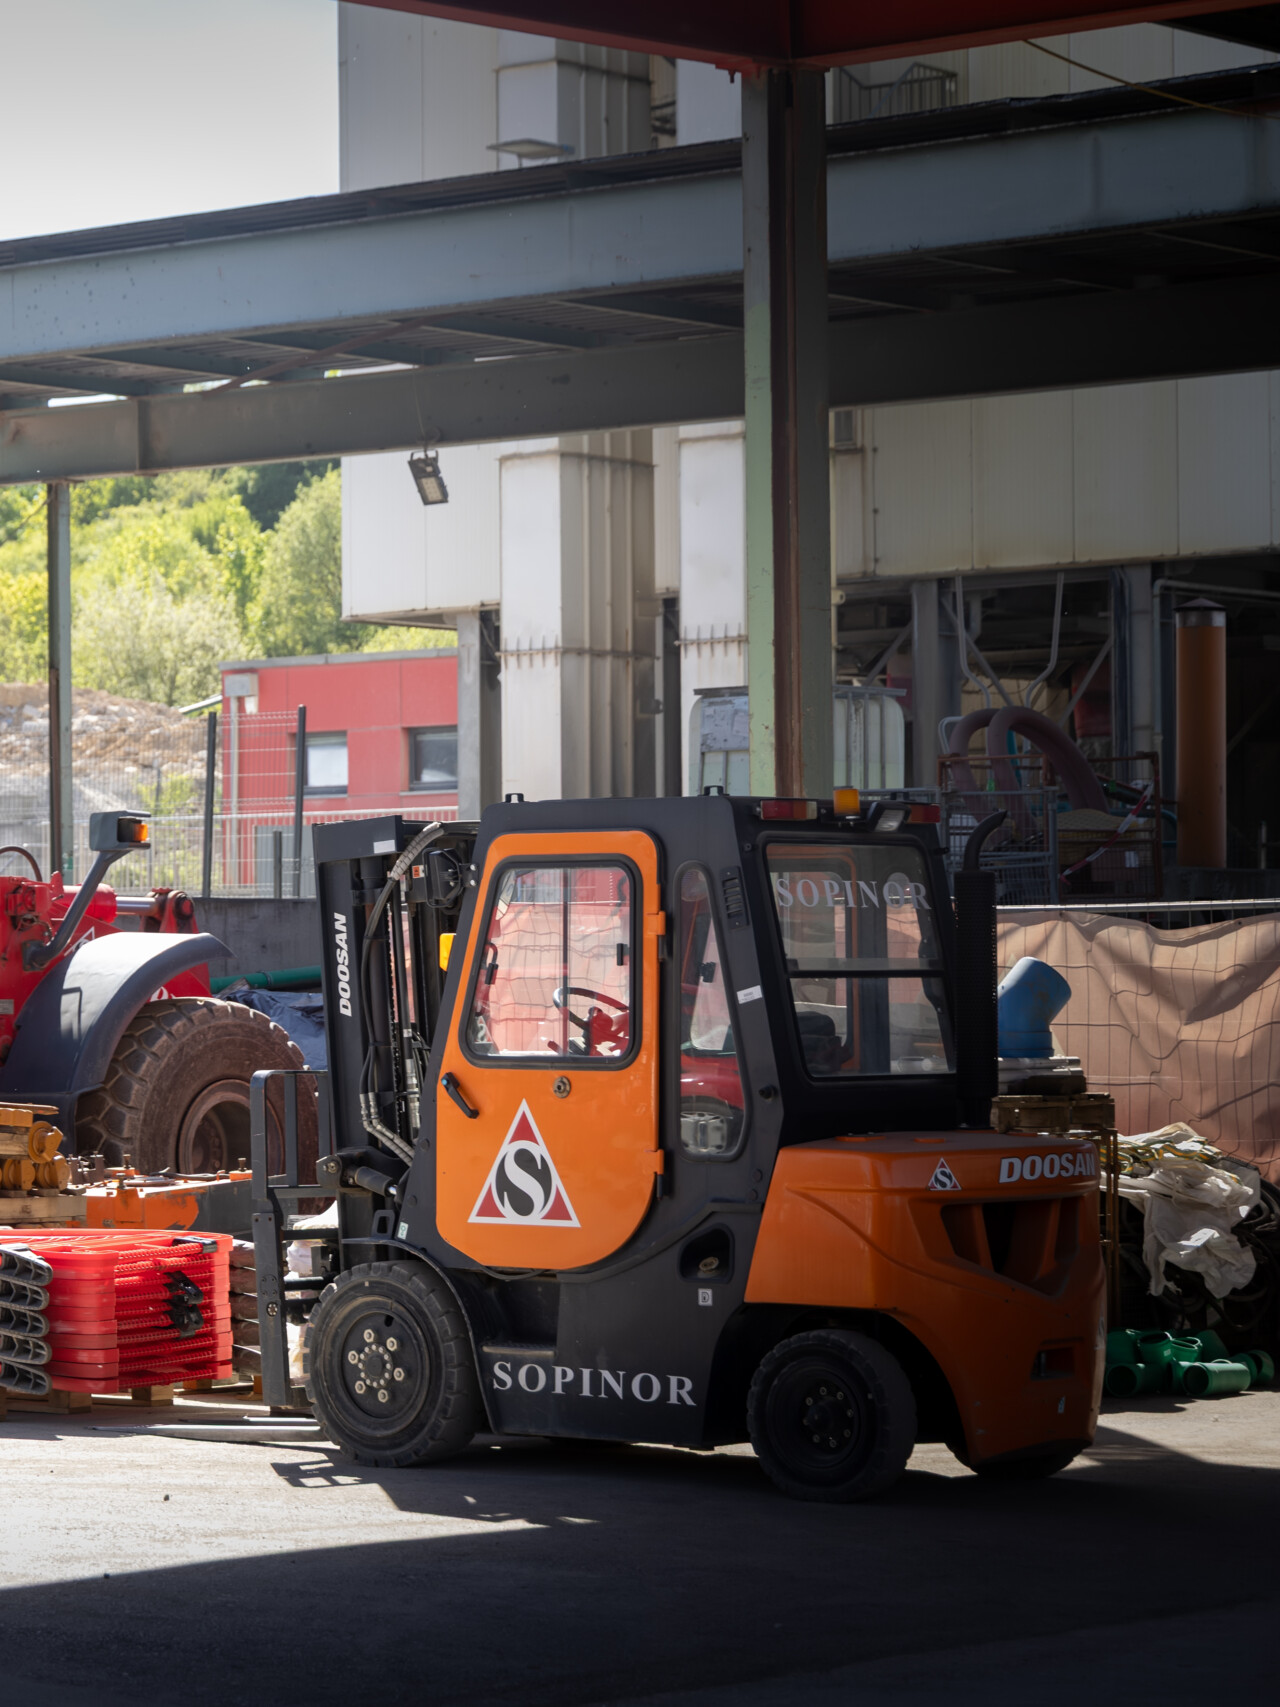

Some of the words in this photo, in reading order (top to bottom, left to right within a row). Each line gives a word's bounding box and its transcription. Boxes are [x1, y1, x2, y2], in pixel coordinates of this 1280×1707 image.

[775, 878, 932, 910] SOPINOR
[333, 912, 352, 1017] DOOSAN
[503, 1140, 546, 1221] S
[998, 1152, 1096, 1184] DOOSAN
[493, 1361, 697, 1406] SOPINOR
